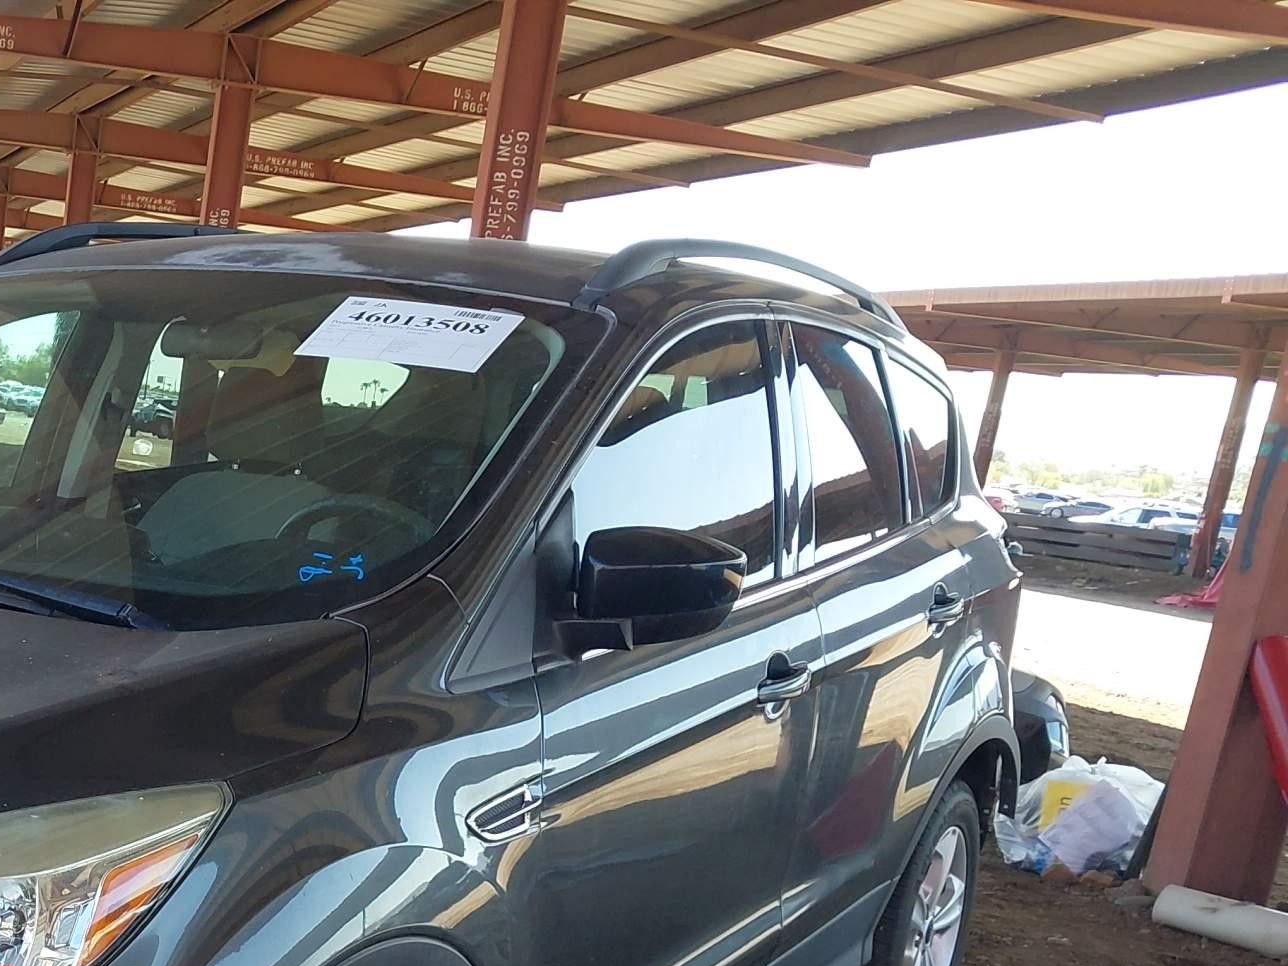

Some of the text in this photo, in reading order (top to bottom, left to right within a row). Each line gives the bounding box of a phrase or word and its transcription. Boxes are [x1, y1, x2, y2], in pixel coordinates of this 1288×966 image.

[454, 87, 474, 101] U.S.
[265, 155, 298, 168] PREFAB
[485, 128, 514, 240] PREFAB INC.
[348, 310, 490, 335] 46013508
